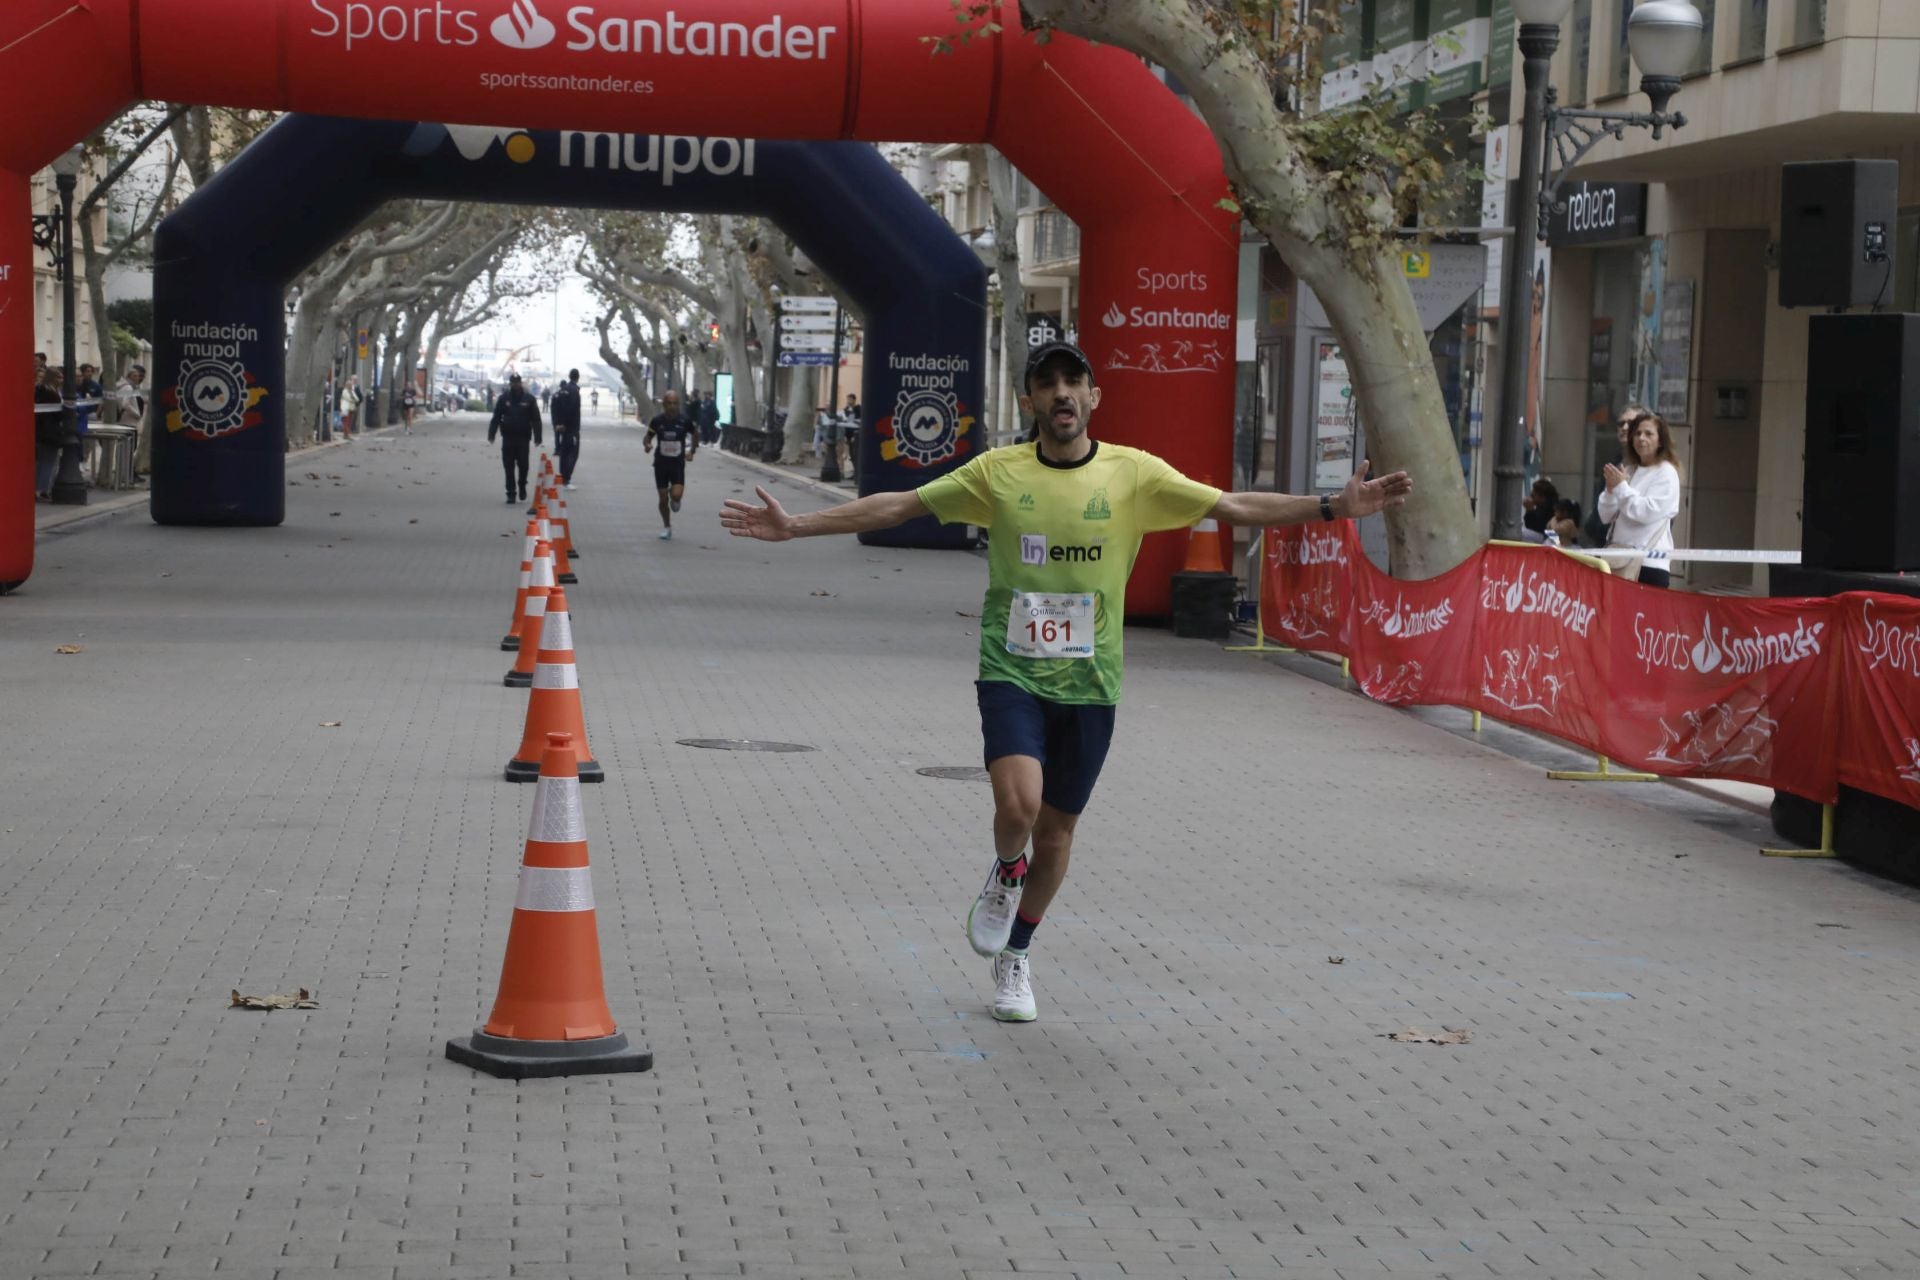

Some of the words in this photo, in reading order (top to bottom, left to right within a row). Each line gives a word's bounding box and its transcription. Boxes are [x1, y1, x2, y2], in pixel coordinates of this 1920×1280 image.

[310, 0, 479, 51] Sports
[566, 5, 837, 60] Santander
[479, 72, 655, 95] sportssantander.es
[1567, 180, 1616, 233] rebeca
[1137, 267, 1207, 295] Sports
[171, 319, 258, 341] fundación
[1130, 306, 1231, 330] Santander
[183, 340, 240, 361] mupol
[889, 352, 969, 372] fundación
[901, 371, 954, 391] mupol
[1024, 619, 1071, 643] 161
[1633, 611, 1690, 675] Sports
